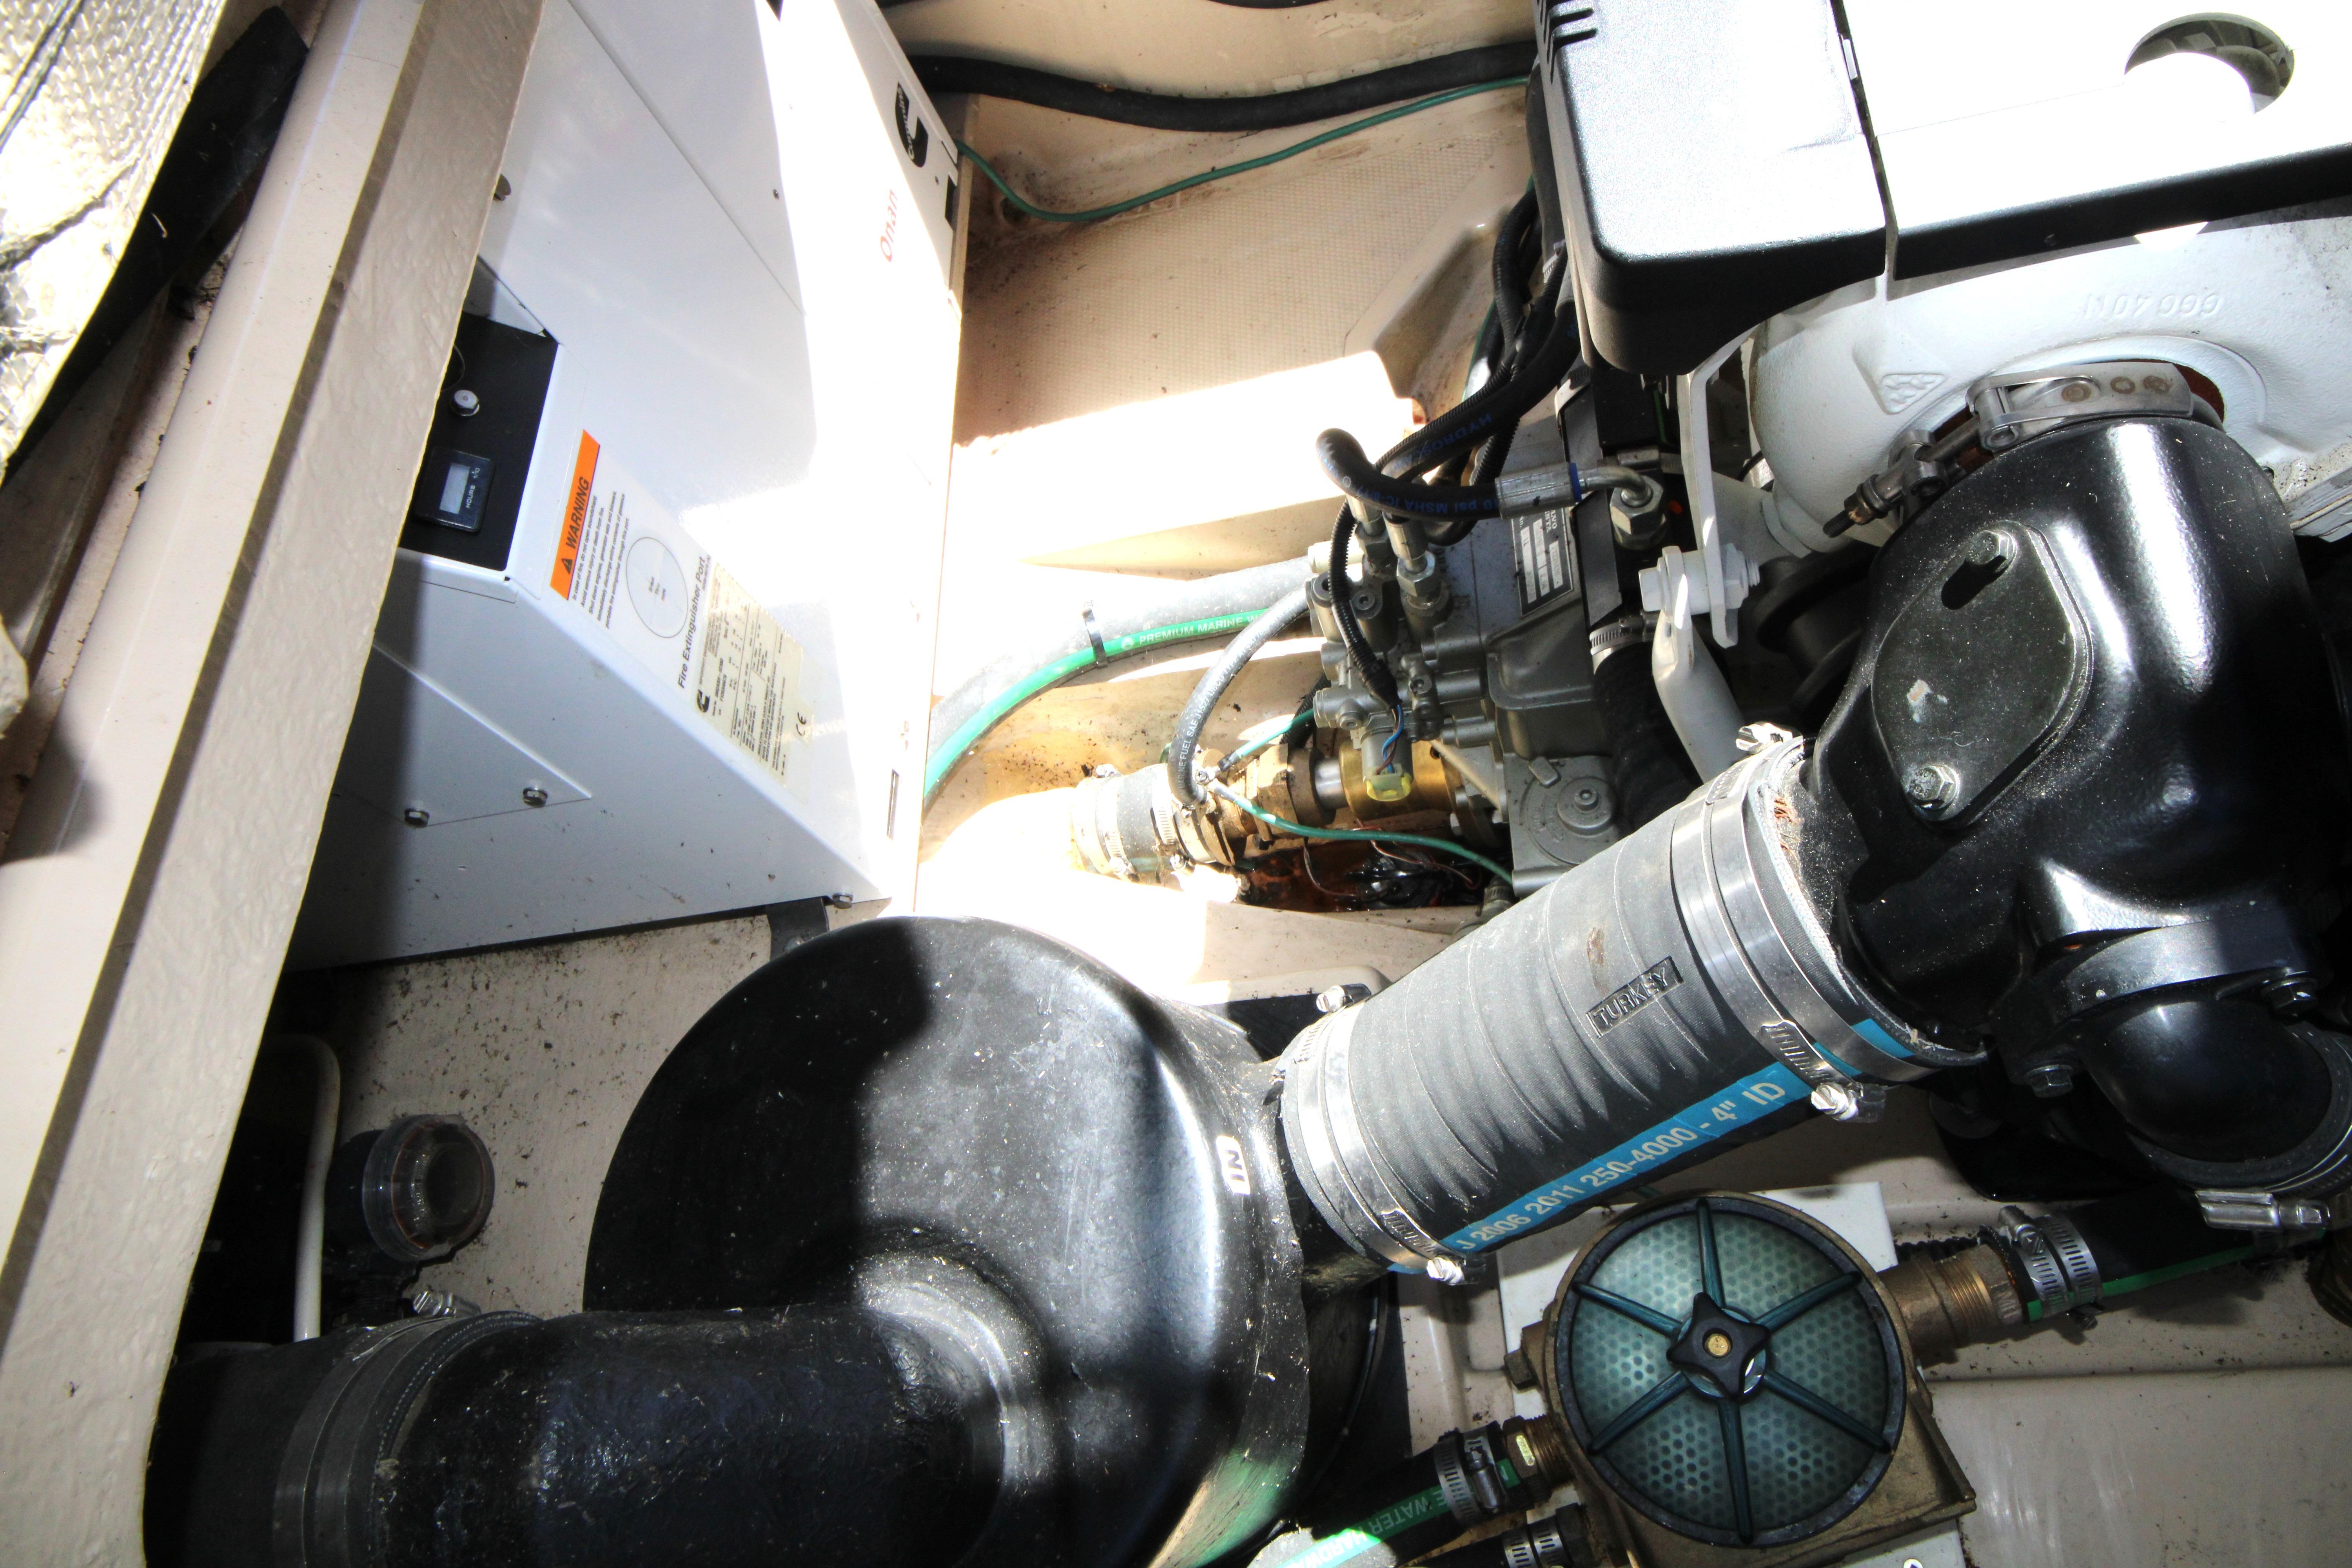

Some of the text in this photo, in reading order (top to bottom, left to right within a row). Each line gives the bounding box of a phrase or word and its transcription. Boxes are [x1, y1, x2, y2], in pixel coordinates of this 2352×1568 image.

[879, 189, 898, 263] Onan
[465, 485, 476, 509] HOURS
[609, 489, 617, 513] blowers.
[617, 492, 626, 517] gaseous
[1404, 499, 1449, 514] MSHA
[1454, 499, 1477, 513] psi
[565, 474, 590, 552] WARNING
[616, 514, 621, 523] of
[612, 521, 620, 546] contents
[592, 546, 596, 554] or
[599, 535, 609, 563] generator
[572, 592, 577, 601] In
[576, 572, 581, 581] of
[580, 552, 585, 562] do
[595, 560, 604, 586] engines,
[603, 560, 613, 589] discharge
[604, 604, 613, 629] portable
[610, 561, 622, 596] extinguisher
[617, 539, 626, 563] through
[596, 587, 608, 622] Immediately
[678, 554, 705, 689] Fire Extinguisher Port
[1139, 625, 1194, 645] PREMIUM
[1198, 617, 1243, 633] MARINE
[1180, 739, 1192, 760] FUEL
[1187, 719, 1199, 737] SAE
[1194, 695, 1210, 719] J1527
[1594, 966, 1675, 1024] TURKEY
[1225, 1149, 1246, 1182] IN
[1463, 1239, 1475, 1250] J
[1470, 1214, 1531, 1242] 2006
[1525, 1185, 1585, 1215] 2011
[1581, 1126, 1698, 1189] 250-4000
[1712, 1100, 1737, 1122] 4"
[1743, 1082, 1786, 1106] ID
[1367, 1497, 1431, 1535] WATER
